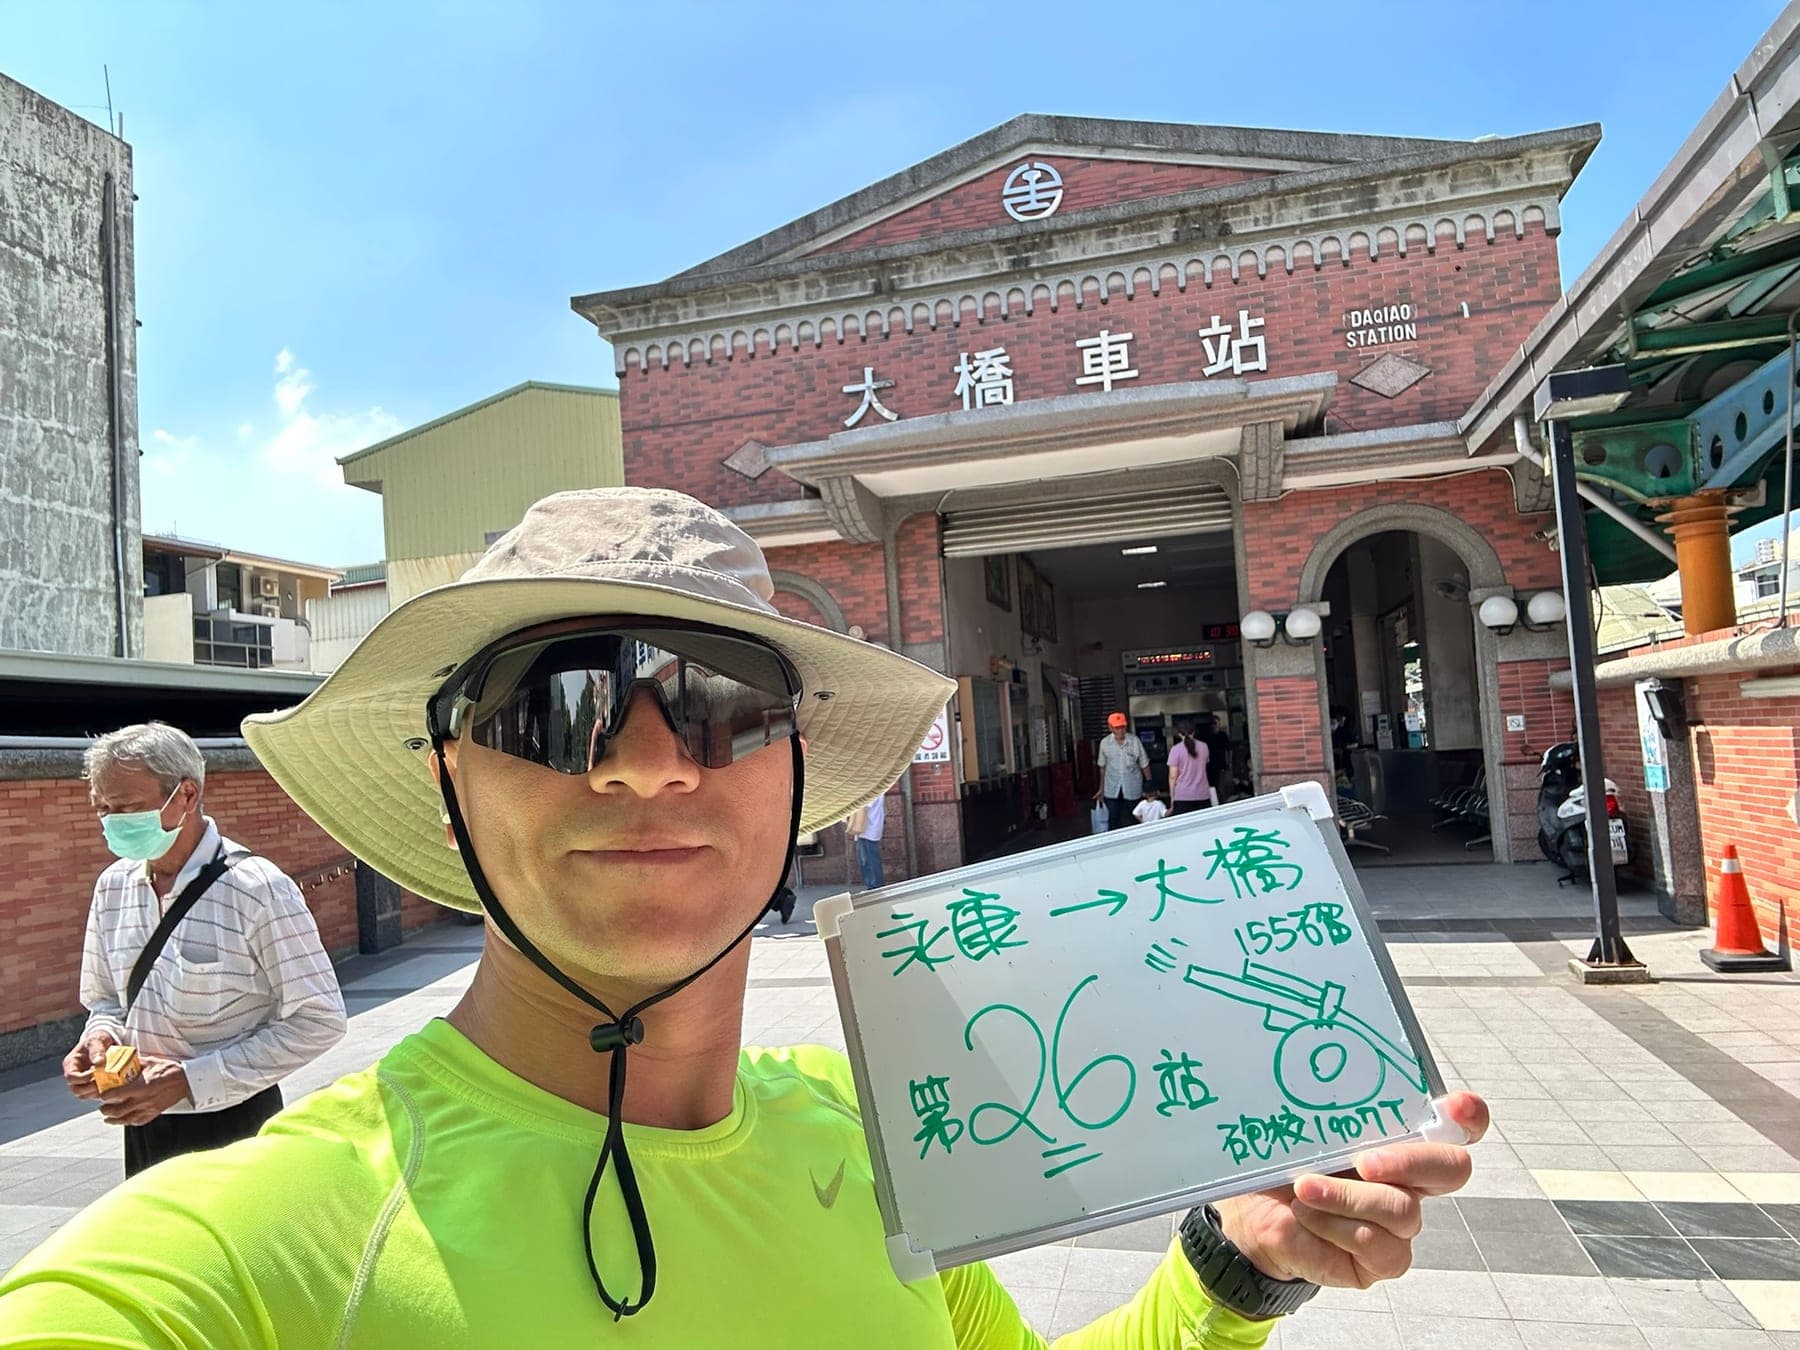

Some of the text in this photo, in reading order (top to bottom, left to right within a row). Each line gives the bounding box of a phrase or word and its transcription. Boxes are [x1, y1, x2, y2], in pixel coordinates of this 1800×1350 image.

[1346, 322, 1417, 348] STATION
[1350, 304, 1410, 327] DAQIAO
[842, 309, 1268, 428] 大橋車站
[1134, 826, 1302, 923] 大橋
